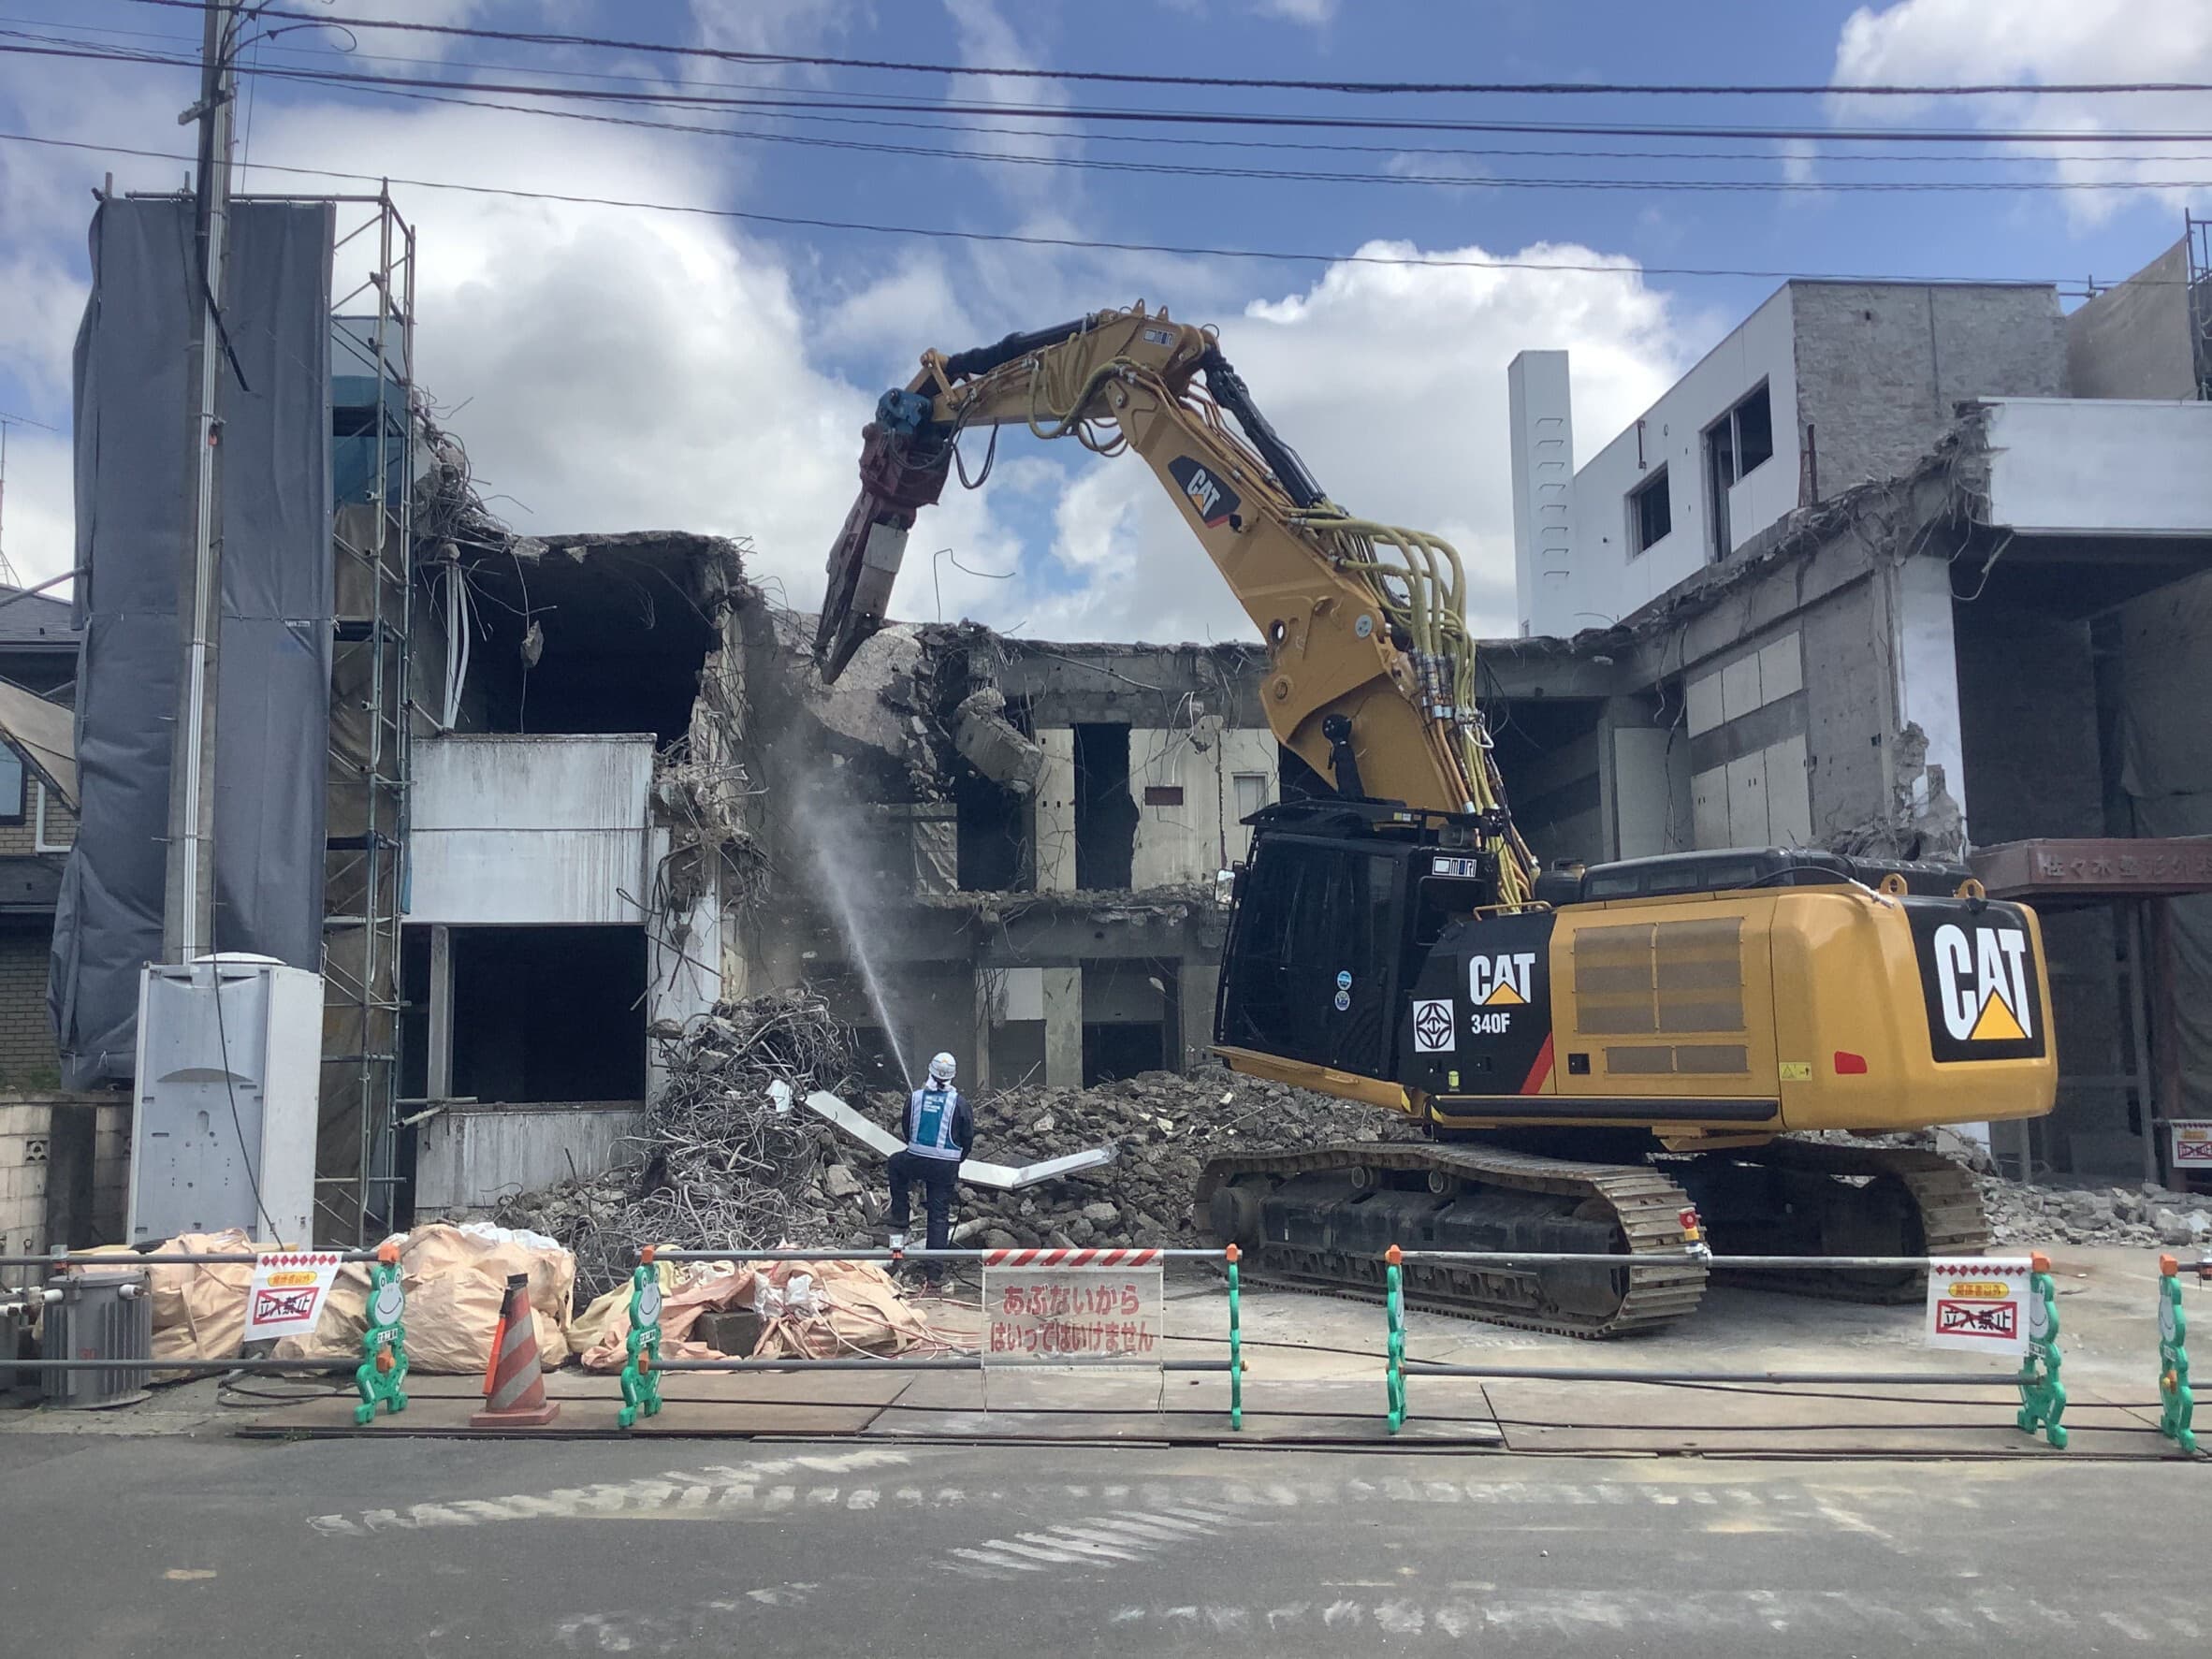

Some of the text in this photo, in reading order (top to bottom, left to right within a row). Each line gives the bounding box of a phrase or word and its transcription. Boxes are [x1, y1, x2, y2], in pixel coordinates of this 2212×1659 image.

[1186, 468, 1220, 517] CAT
[1469, 953, 1535, 1006] CAT
[1933, 924, 2032, 1041] CAT
[1471, 1012, 1510, 1034] 340F
[258, 1296, 311, 1317] 立入禁止
[1003, 1284, 1140, 1316] あぶないから
[990, 1320, 1154, 1352] はいってはいけません
[1943, 1309, 2012, 1332] 立入禁止
